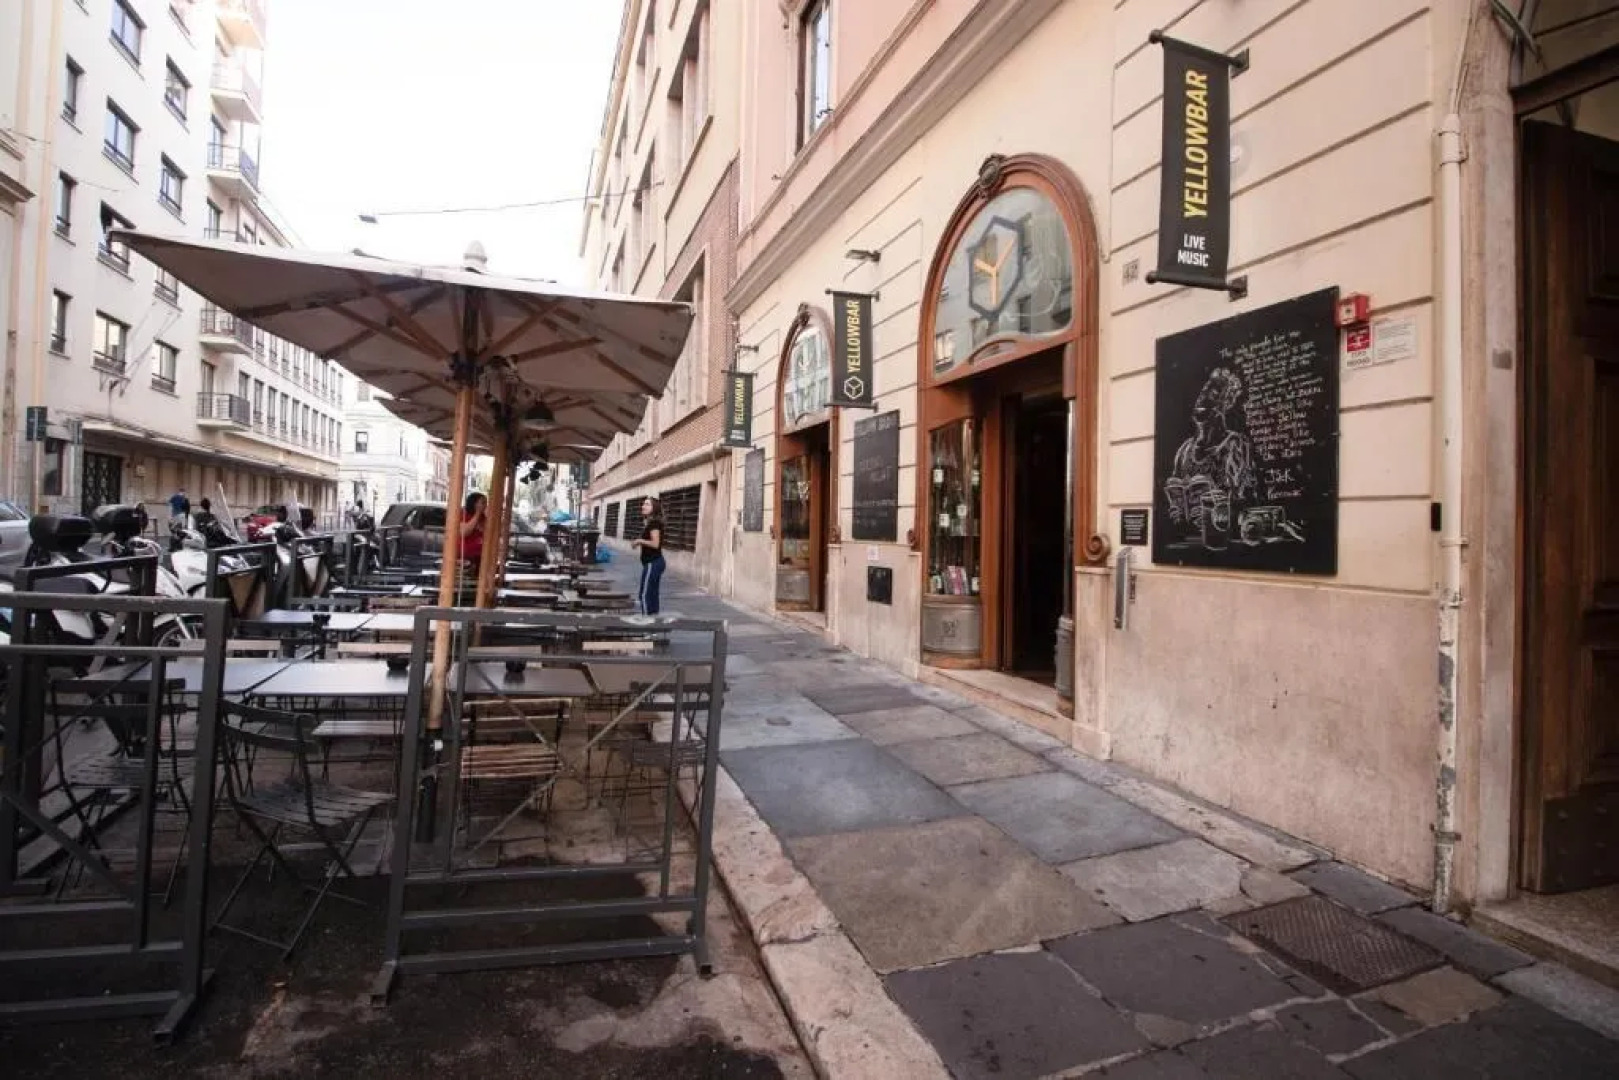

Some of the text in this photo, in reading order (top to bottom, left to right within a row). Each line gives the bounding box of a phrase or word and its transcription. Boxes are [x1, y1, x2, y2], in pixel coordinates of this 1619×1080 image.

[1183, 70, 1209, 218] YELLOWBAR
[1177, 250, 1209, 267] MUSIC
[1183, 233, 1206, 250] LIVE
[846, 299, 861, 374] YELLOWBAR
